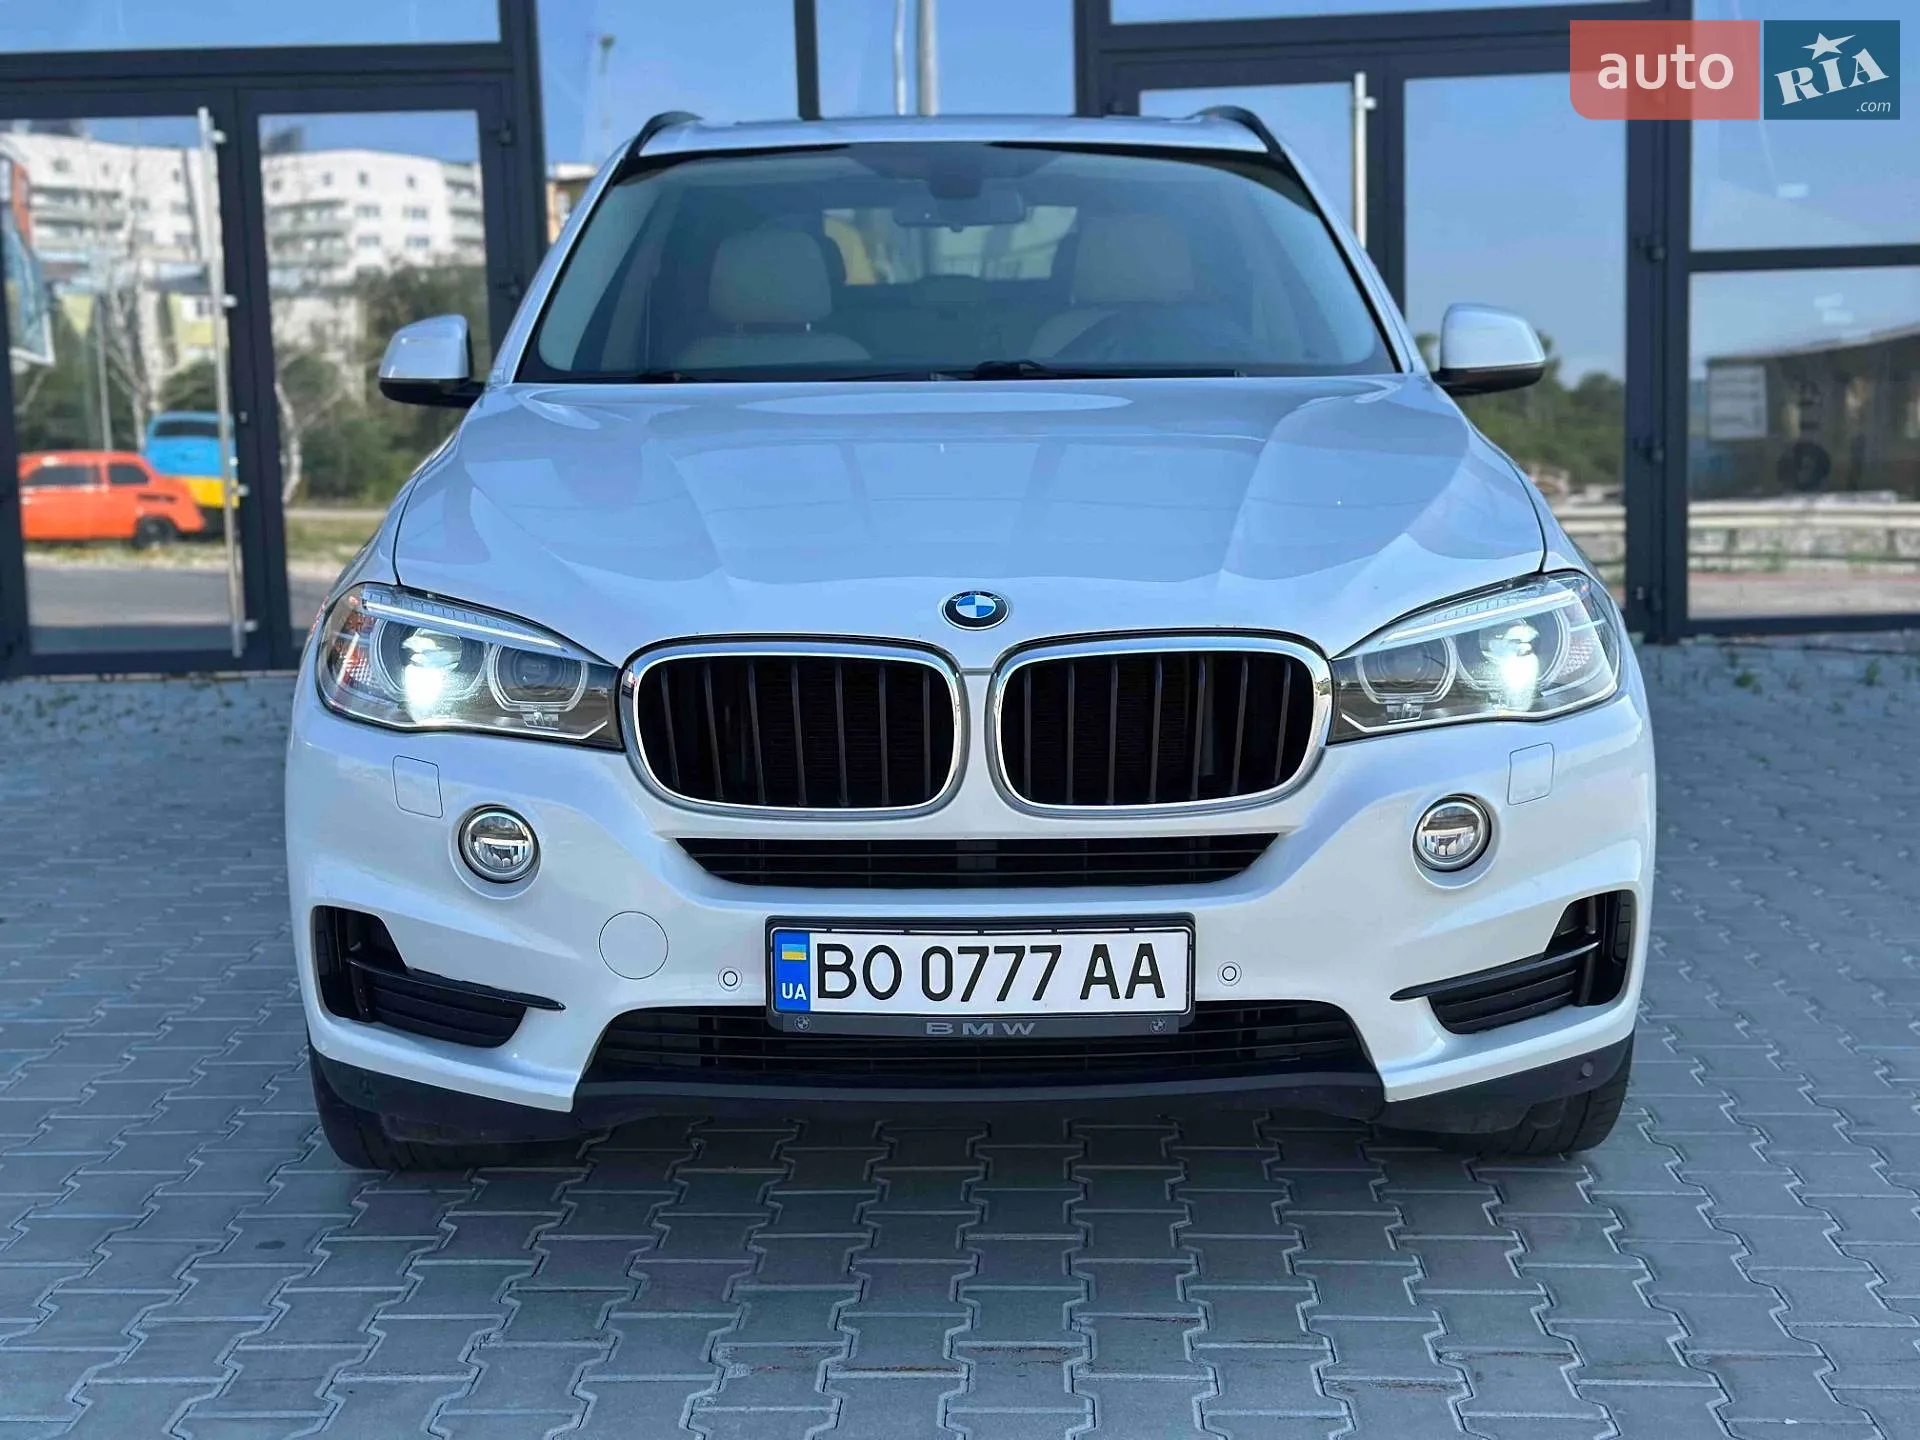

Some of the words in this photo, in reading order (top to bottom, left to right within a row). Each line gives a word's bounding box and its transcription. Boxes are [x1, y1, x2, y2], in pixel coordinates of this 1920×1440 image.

[816, 943, 902, 999] BO
[921, 945, 1061, 1002] 0777
[1080, 943, 1165, 1000] AA
[781, 983, 807, 1000] UA
[926, 1022, 1035, 1035] BMW
